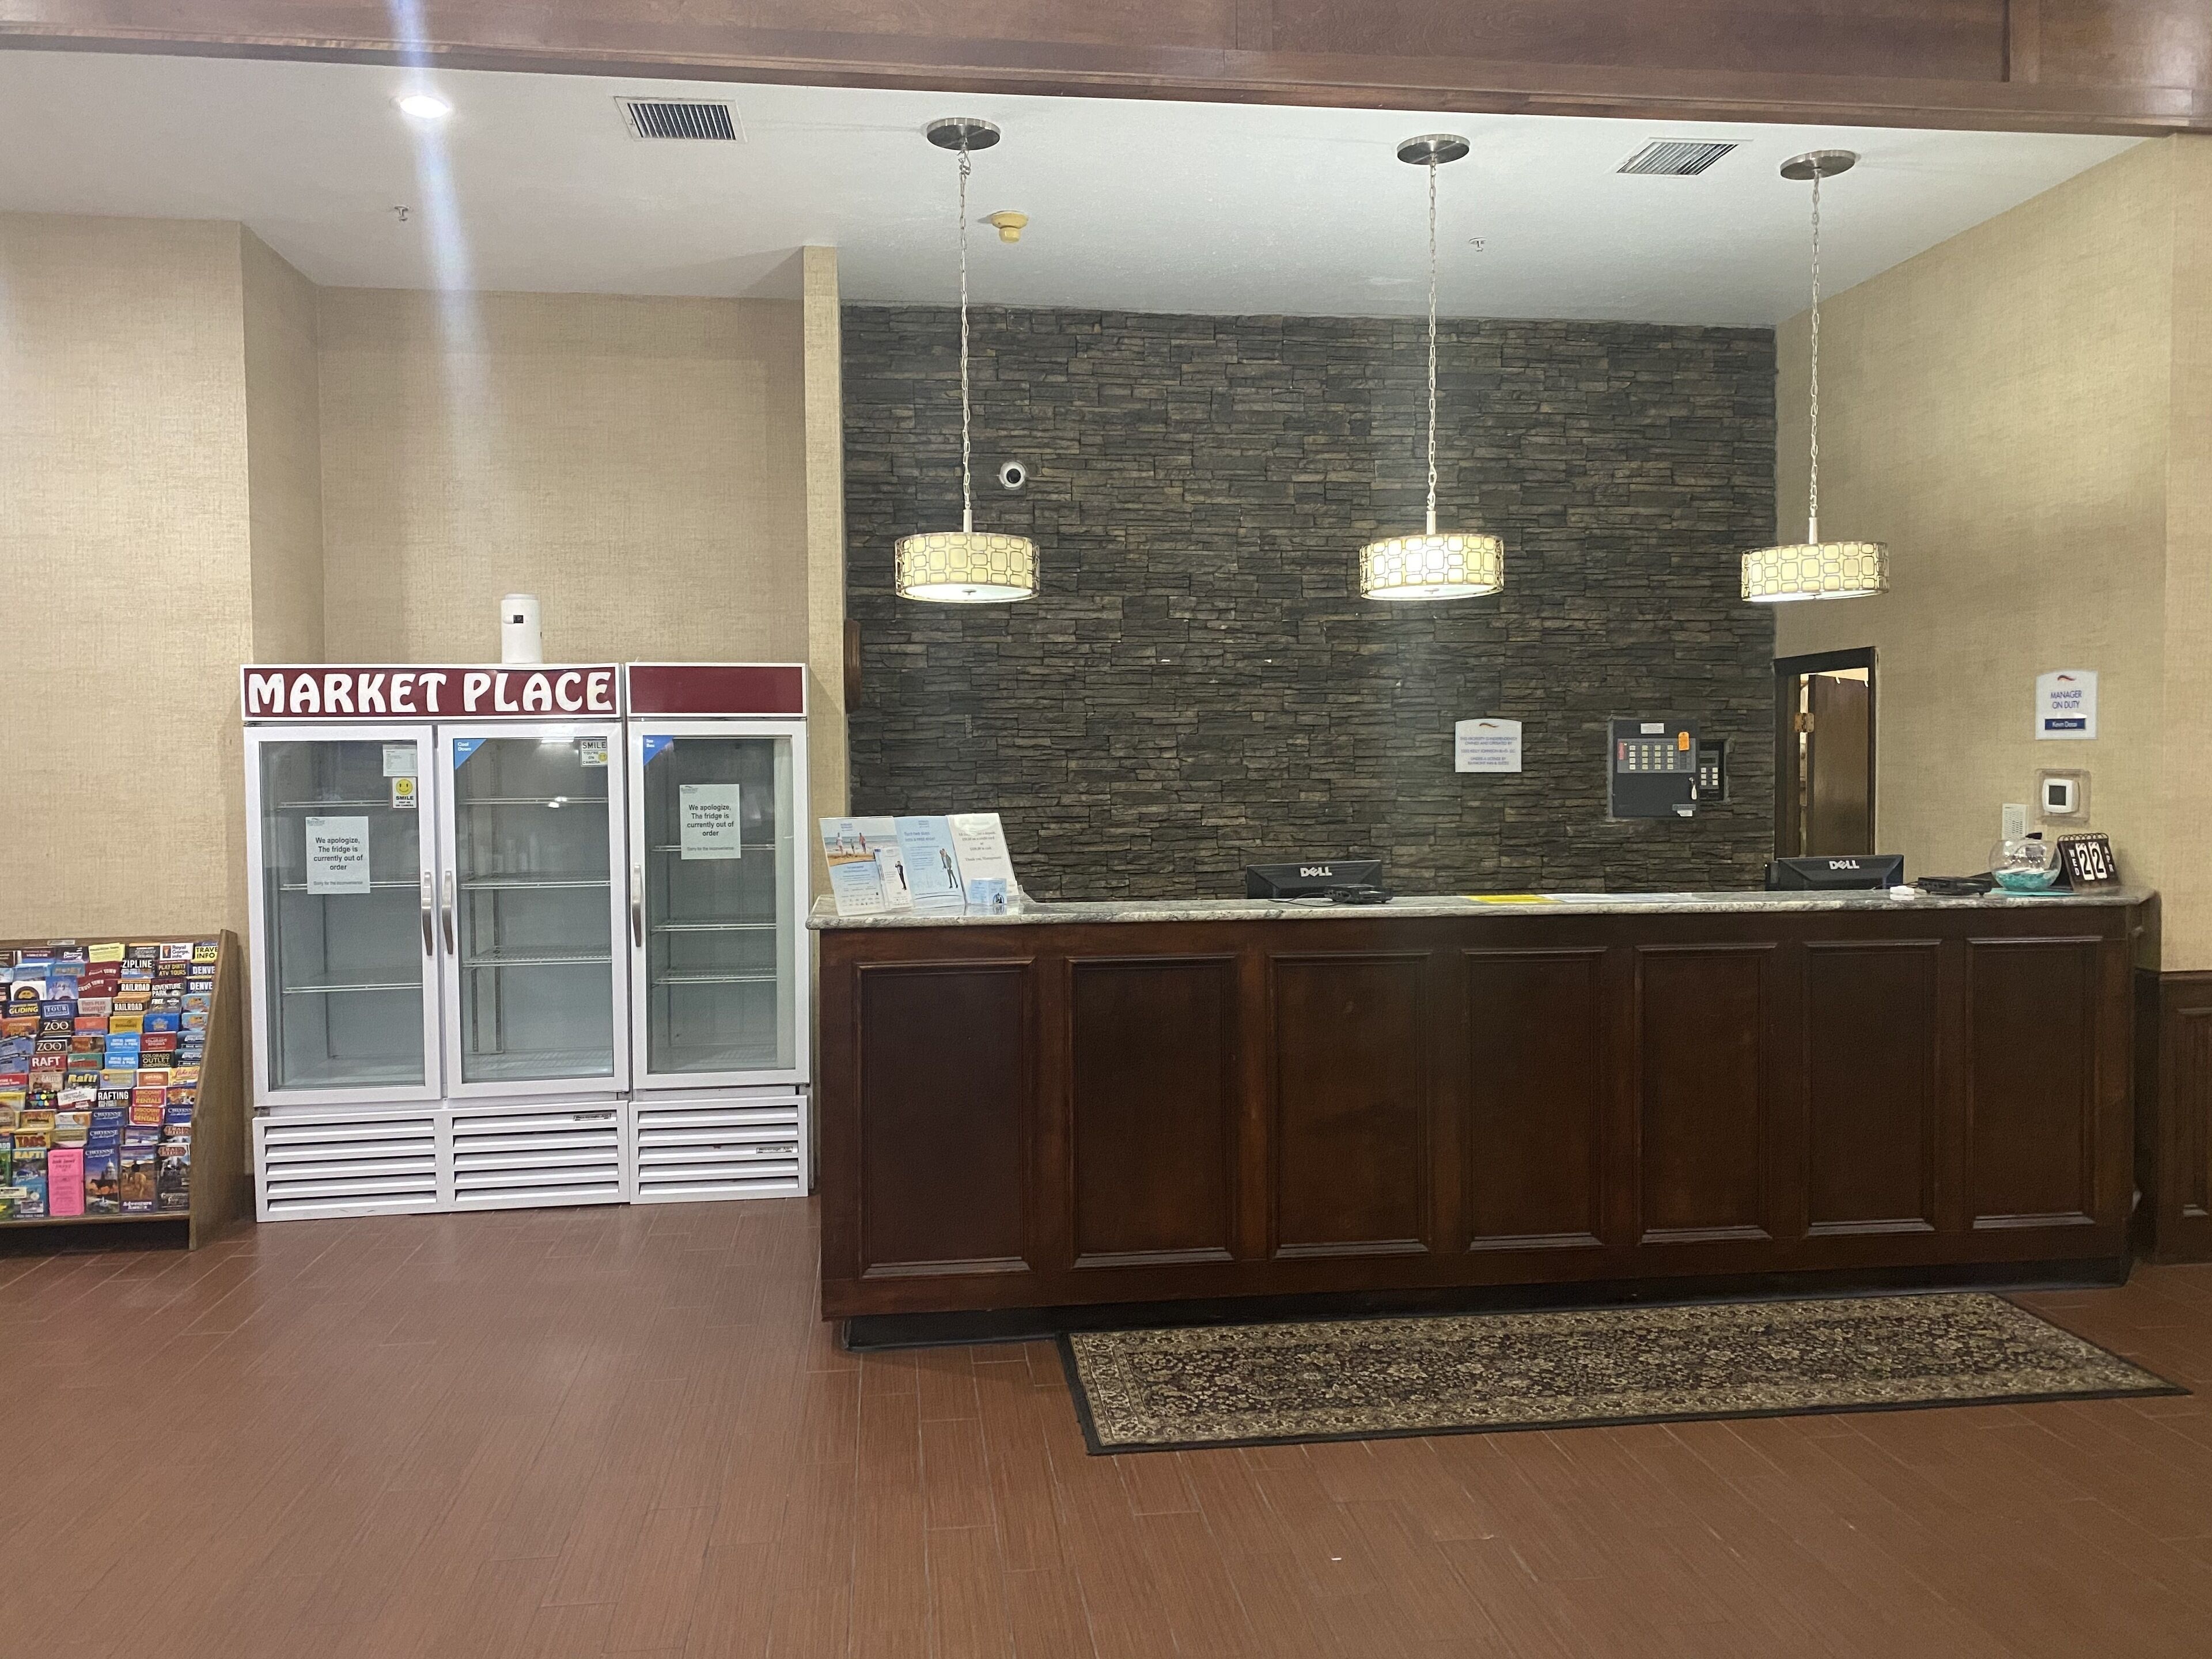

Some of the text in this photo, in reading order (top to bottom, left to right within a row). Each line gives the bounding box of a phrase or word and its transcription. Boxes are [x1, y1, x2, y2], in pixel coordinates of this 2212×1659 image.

[249, 671, 613, 713] MARKET PLACE
[2051, 690, 2082, 698] MANAGER
[2052, 700, 2080, 709] ON DUTY
[327, 837, 360, 845] apologize,
[1829, 859, 1860, 870] DELL
[1300, 866, 1332, 877] DELL
[122, 960, 153, 968] ZIPLINE
[192, 965, 215, 975] DENVE
[121, 983, 150, 991] RAILROAD
[190, 982, 213, 990] DENVE
[9, 1006, 39, 1014] GLIDING
[114, 1003, 143, 1011] RAILROAD
[43, 1021, 69, 1031] ZOO
[36, 1042, 62, 1051] ZOO
[32, 1056, 60, 1067] RAFT
[97, 1091, 129, 1101] RAFTING
